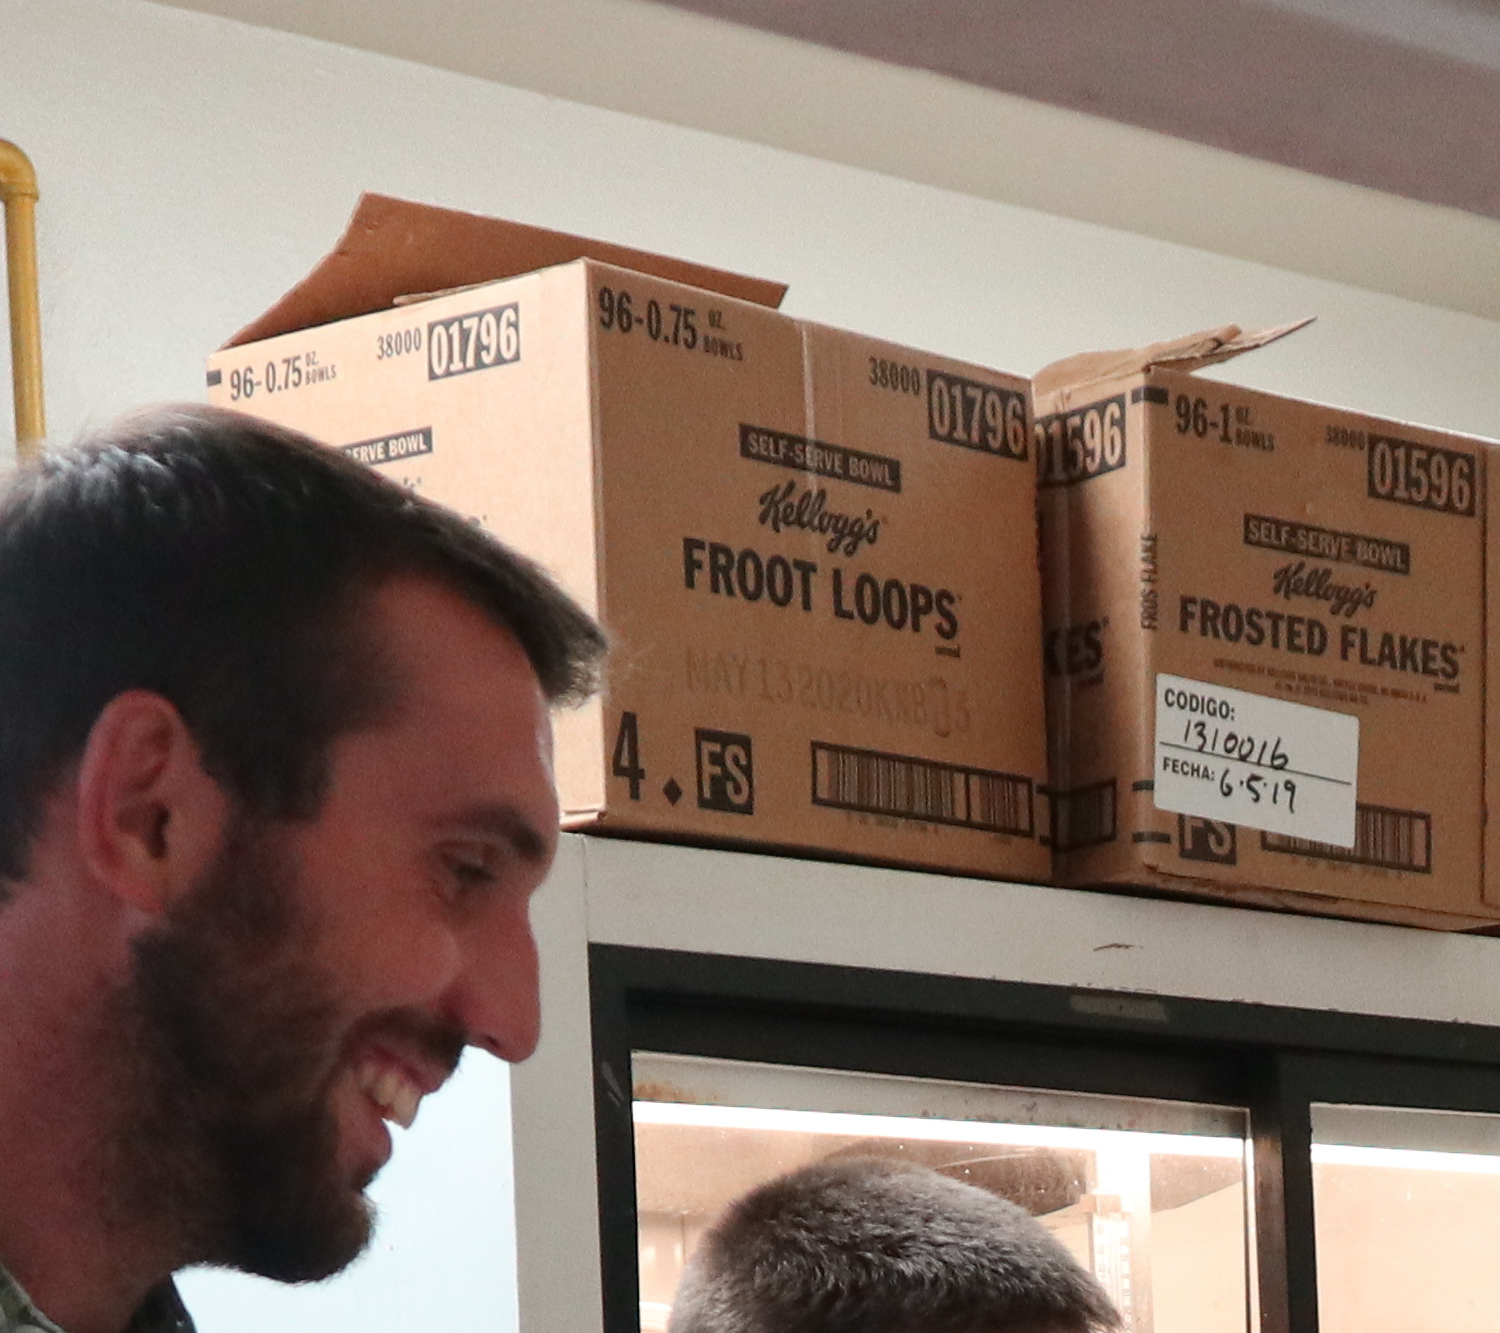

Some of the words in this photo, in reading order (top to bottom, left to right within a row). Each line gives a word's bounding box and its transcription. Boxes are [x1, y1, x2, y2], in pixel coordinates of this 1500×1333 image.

[376, 327, 422, 360] 38000
[431, 306, 518, 377] 01796
[600, 286, 698, 350] 96-0.75
[305, 364, 337, 386] BOWLS
[703, 335, 743, 362] BOWLS
[230, 354, 303, 401] 96-0.75
[868, 356, 920, 396] 38000
[931, 379, 1026, 455] 01796
[389, 432, 429, 456] BOWL
[1175, 393, 1231, 445] 96-1
[748, 431, 842, 474] SELF-SERVE
[849, 456, 896, 487] BOWL
[1372, 440, 1472, 511] 01596
[758, 479, 881, 557] Kellogg's
[1249, 518, 1349, 563] SELF-SERVE
[1357, 547, 1405, 571] BOWL
[683, 536, 818, 613] FROOT
[832, 567, 960, 641] LOOPS
[1273, 562, 1378, 618] Kellogg's
[1180, 594, 1329, 657] FROSTED
[1340, 623, 1461, 680] FLAKES
[1165, 688, 1235, 721] CODIGO:
[1163, 756, 1215, 782] FECHA:
[1184, 719, 1290, 771] 1310016
[703, 742, 750, 806] FS
